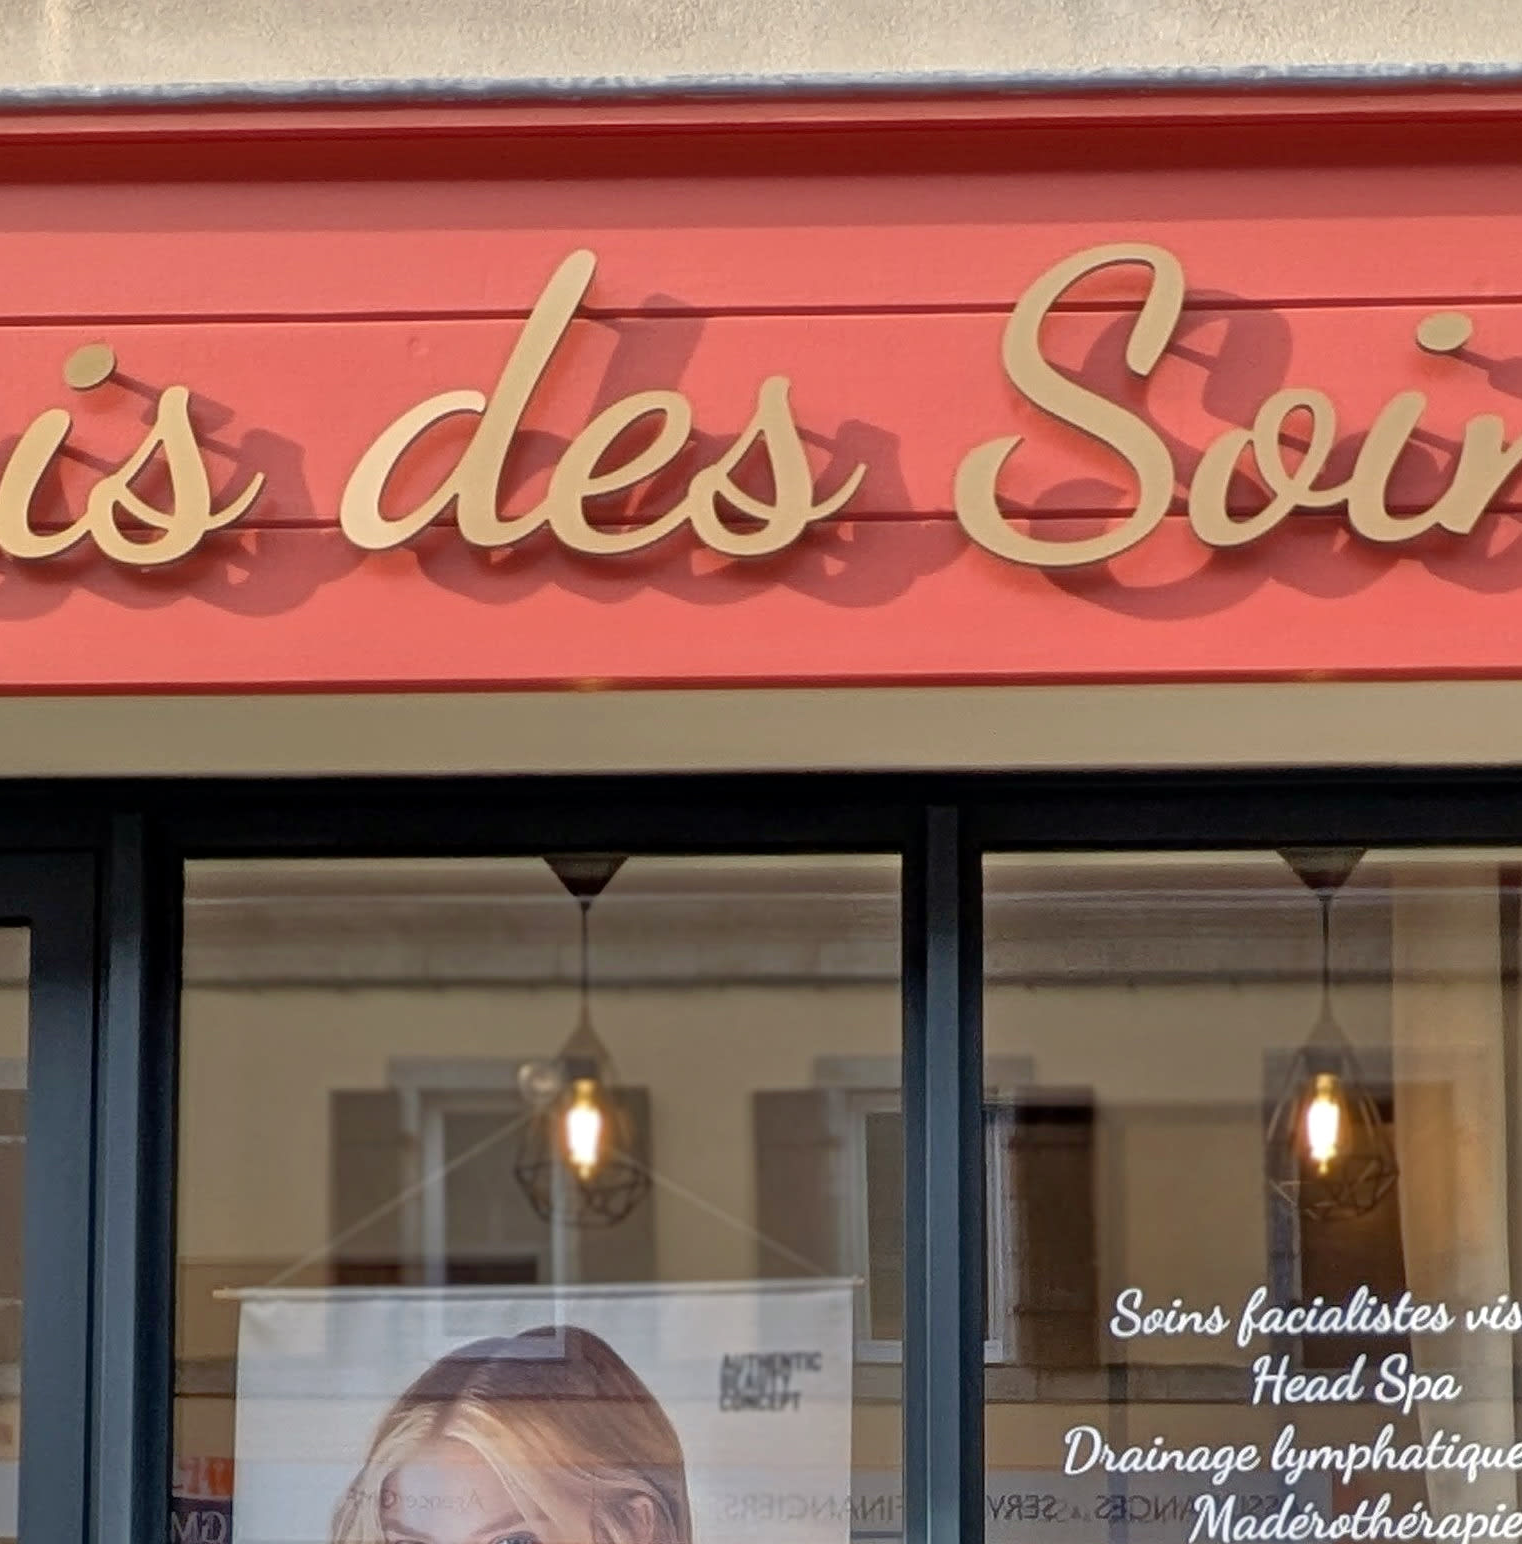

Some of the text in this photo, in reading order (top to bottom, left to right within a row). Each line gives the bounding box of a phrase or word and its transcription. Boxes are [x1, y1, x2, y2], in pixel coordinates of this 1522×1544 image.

[337, 247, 867, 560] des
[1110, 1288, 1229, 1340] Soins
[1236, 1286, 1454, 1346] facialistes
[1252, 1353, 1462, 1415] Head Spa
[1063, 1425, 1261, 1482] Drainage
